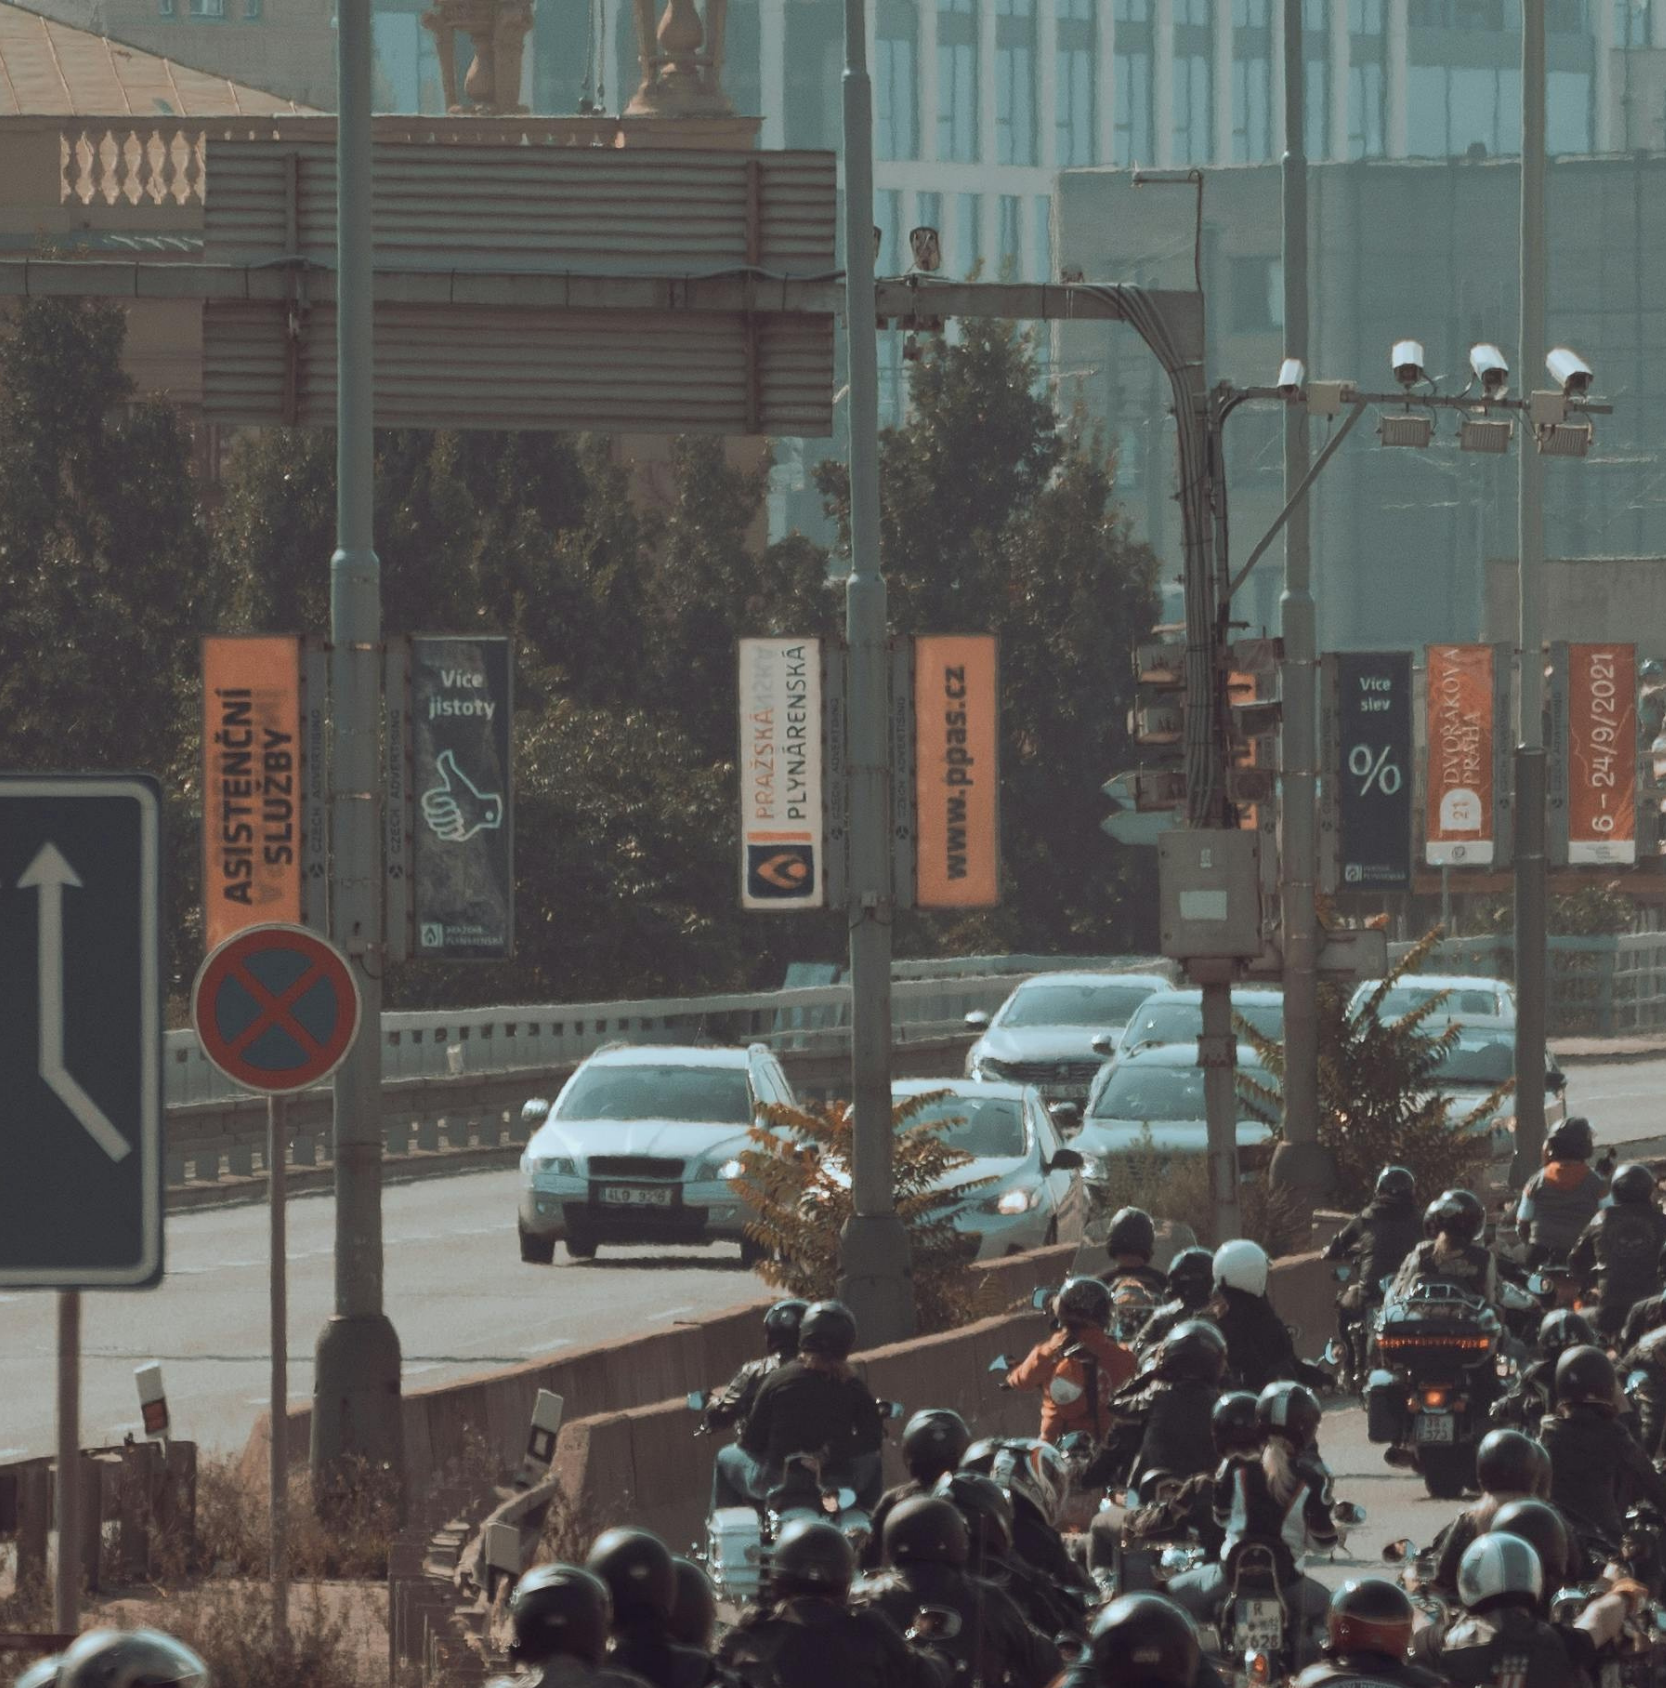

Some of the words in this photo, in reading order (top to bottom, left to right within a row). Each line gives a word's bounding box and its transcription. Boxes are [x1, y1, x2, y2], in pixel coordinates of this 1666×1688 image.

[441, 669, 484, 688] Více
[1360, 677, 1391, 692] Více
[1360, 698, 1391, 712] slev
[429, 699, 495, 720] jistoty
[782, 645, 806, 820] PLYNÁRENSKÁ
[1440, 648, 1462, 784] DVOŘÁKOVA
[1590, 653, 1617, 787] 24/9/2021
[749, 707, 775, 819] PRAŽSKÁ
[945, 665, 974, 881] www.ppas.cz
[1463, 711, 1481, 785] PRAHA
[214, 688, 252, 905] ASISTENČNÍ
[255, 729, 293, 865] SLUŽBY
[1452, 800, 1469, 821] 21
[1592, 814, 1614, 832] 6
[311, 807, 322, 853] CZECH
[390, 808, 400, 855] CZECH
